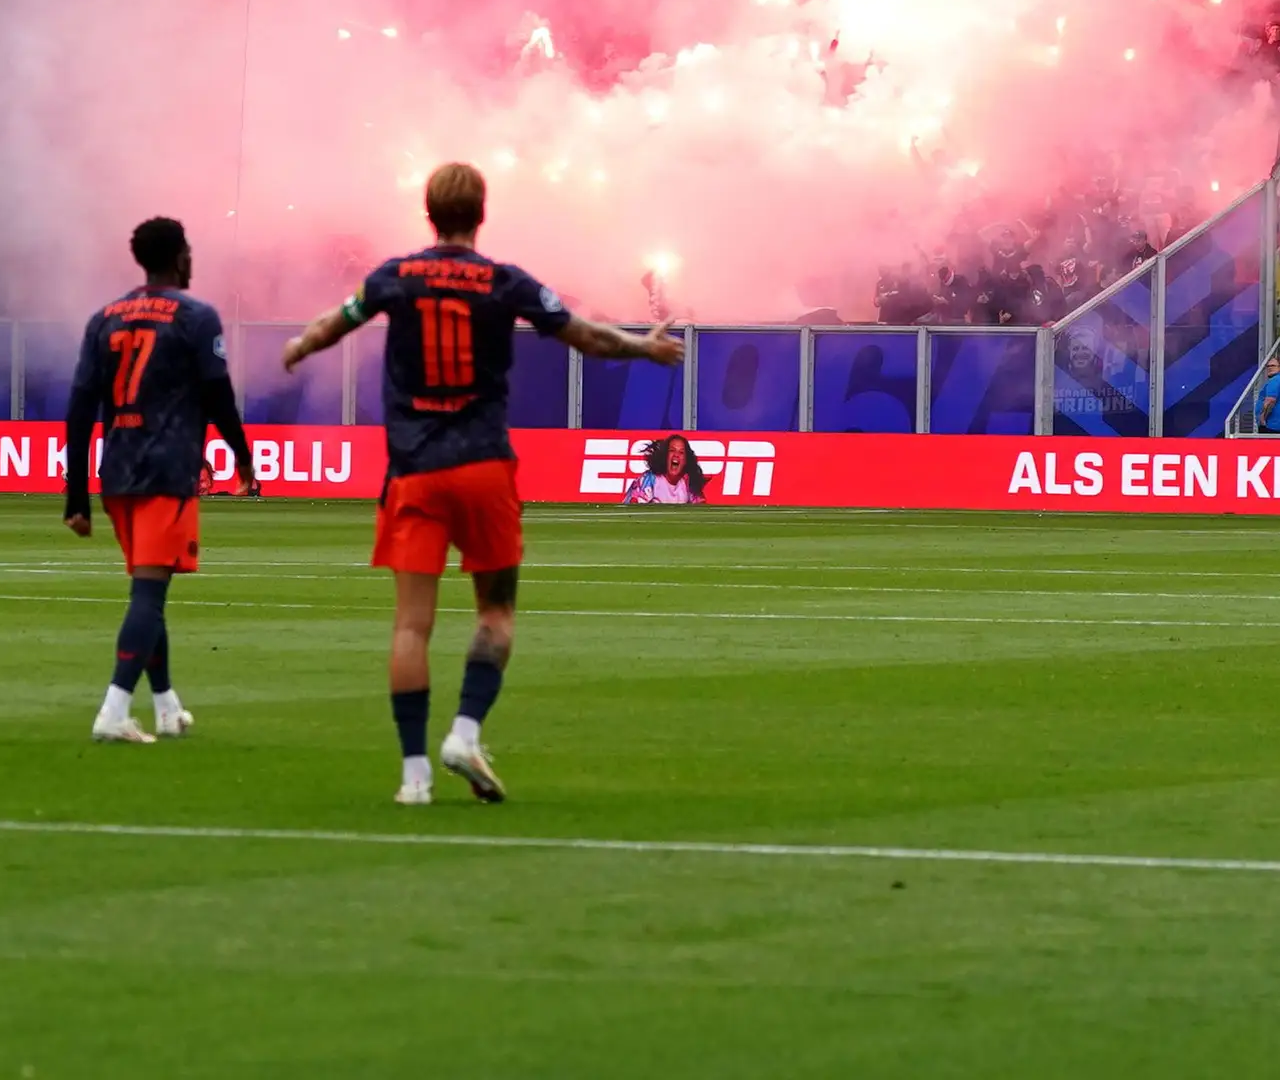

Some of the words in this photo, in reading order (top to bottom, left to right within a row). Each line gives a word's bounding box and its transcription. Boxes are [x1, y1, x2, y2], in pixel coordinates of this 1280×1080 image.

[252, 439, 352, 484] BLIJ
[1008, 451, 1104, 497] ALS
[1121, 453, 1218, 498] EEN
